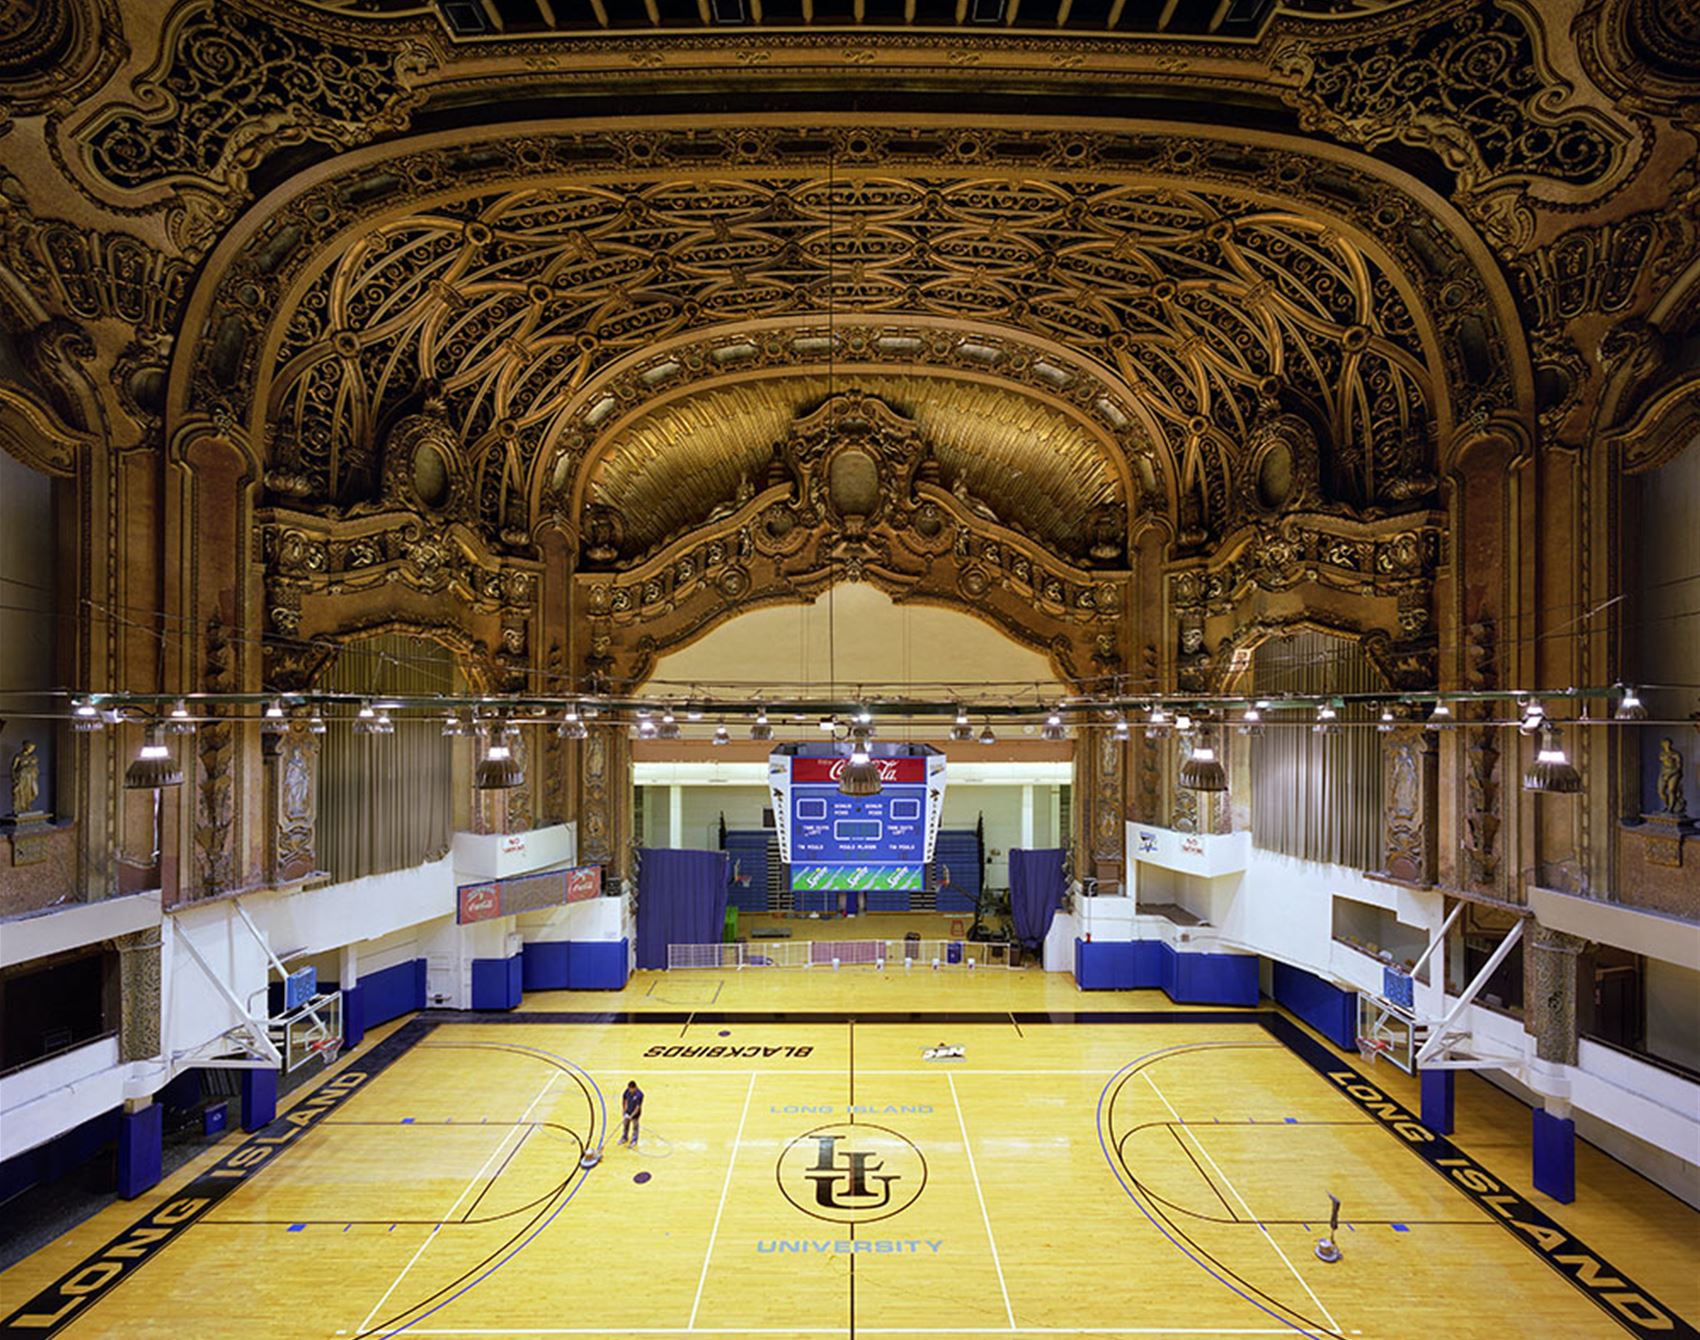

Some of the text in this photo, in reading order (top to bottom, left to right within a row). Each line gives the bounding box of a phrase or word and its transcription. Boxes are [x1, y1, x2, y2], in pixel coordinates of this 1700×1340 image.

[643, 1046, 814, 1058] BLACKBIRDS
[769, 1105, 934, 1114] LONG ISLAND
[8, 1072, 367, 1328] LONG ISLAND
[1327, 1071, 1675, 1330] LONG ISLAND
[757, 1240, 944, 1253] UNIVERSITY
